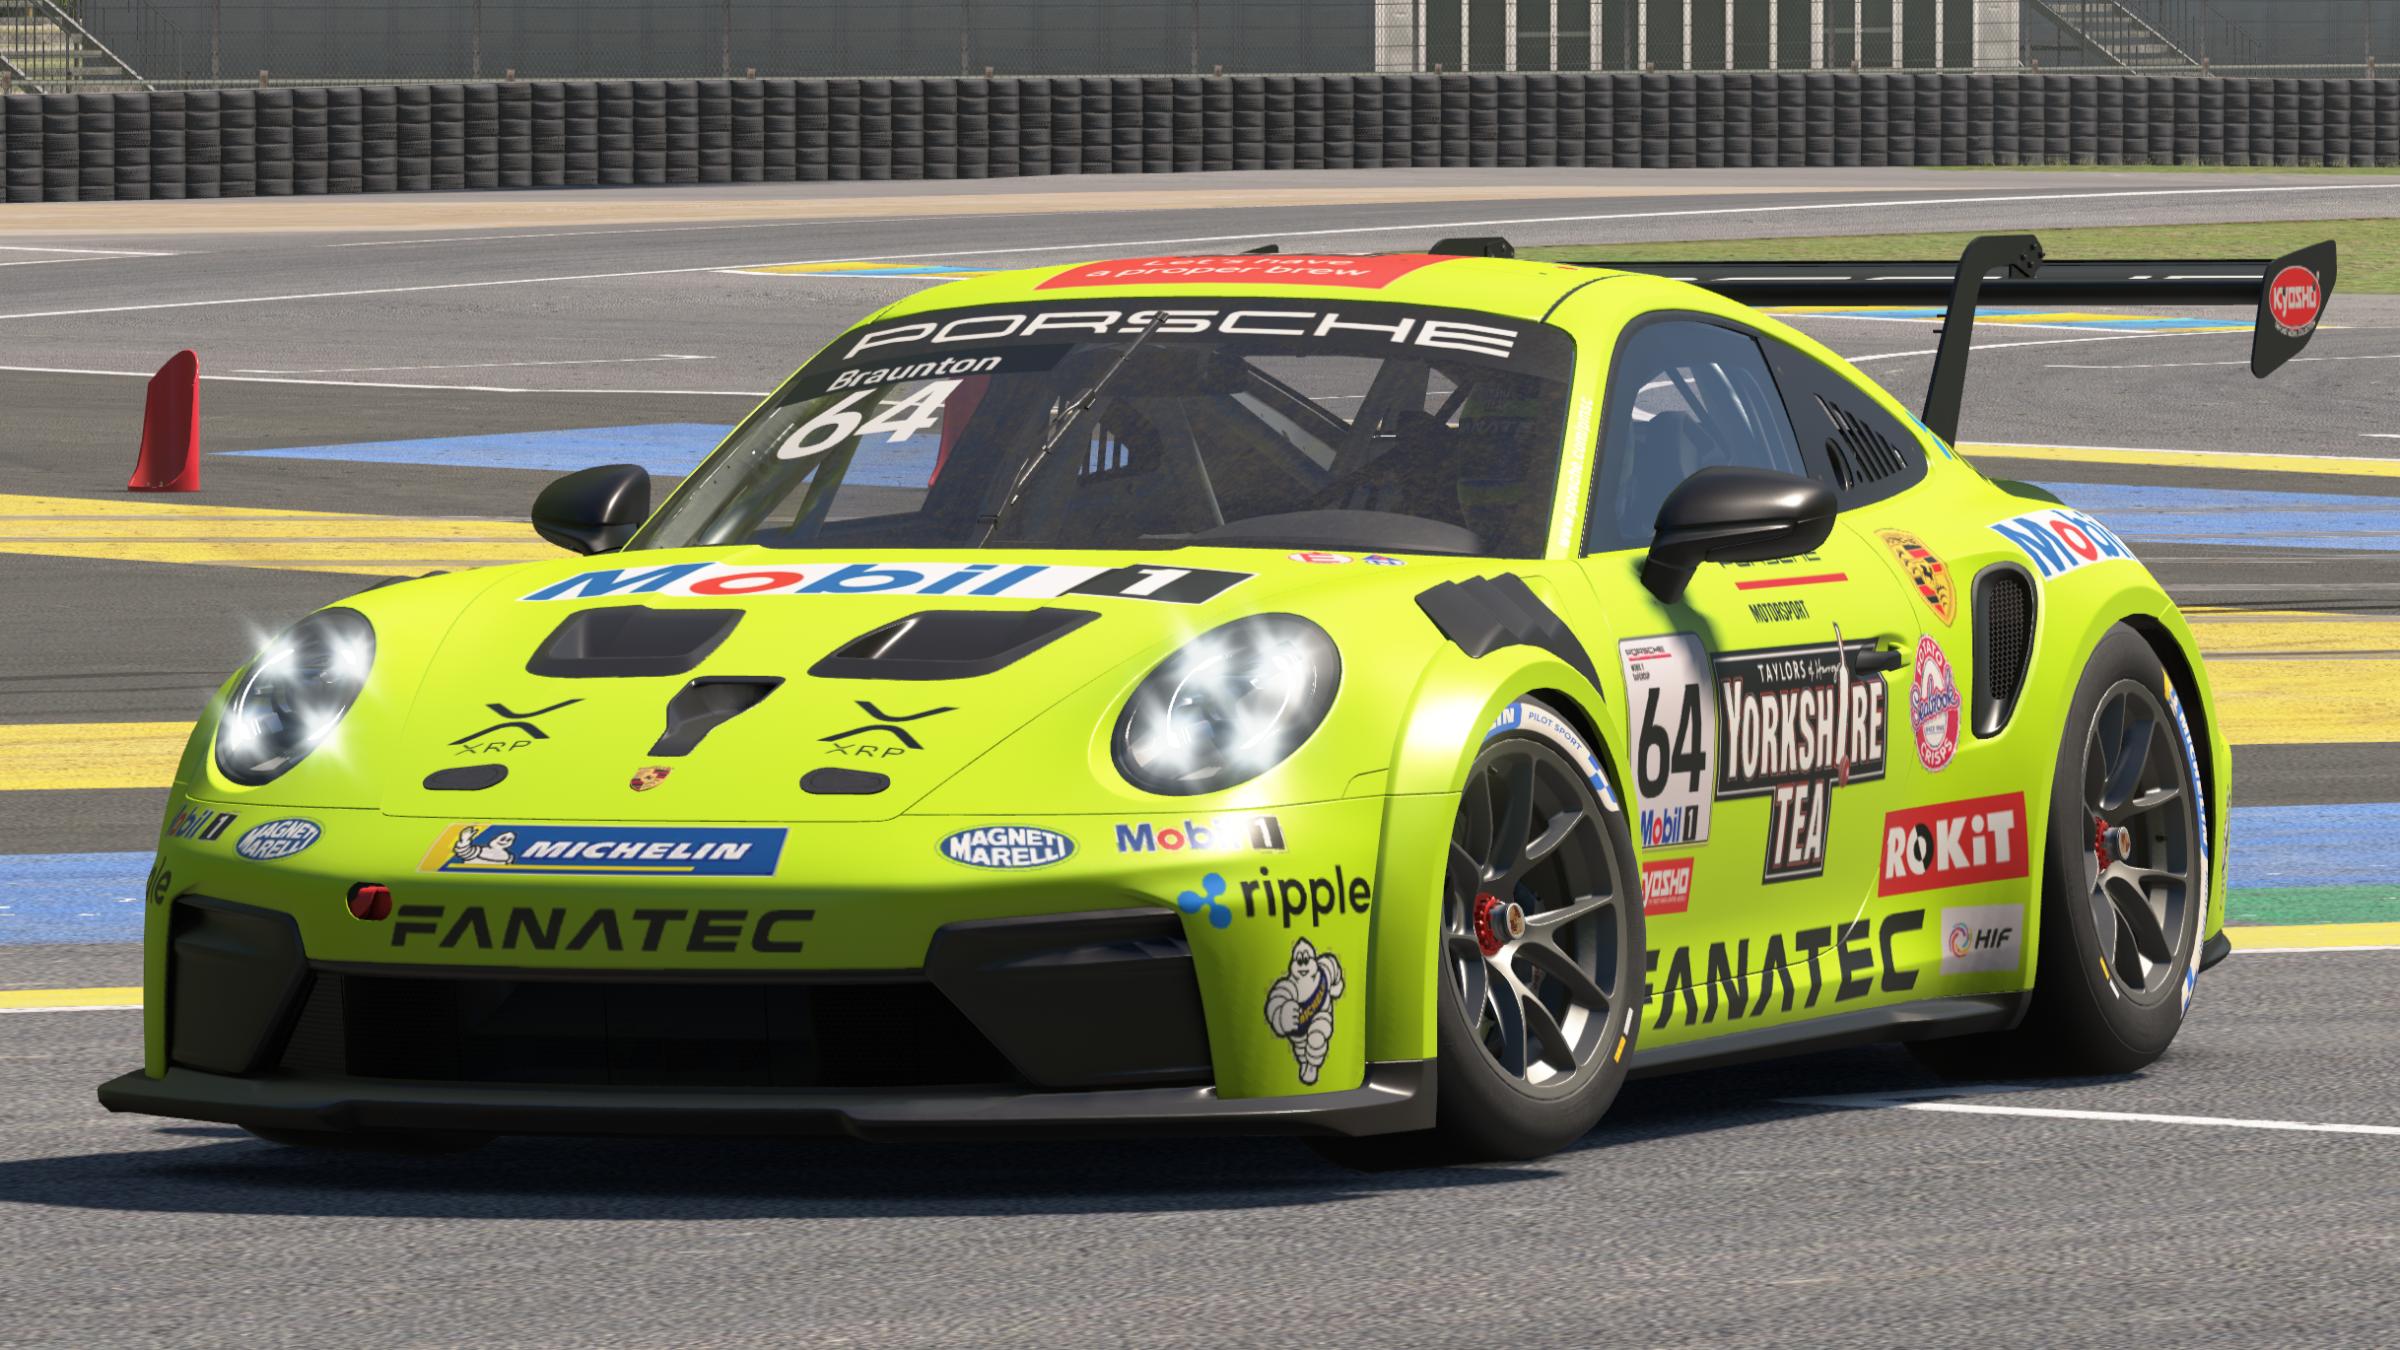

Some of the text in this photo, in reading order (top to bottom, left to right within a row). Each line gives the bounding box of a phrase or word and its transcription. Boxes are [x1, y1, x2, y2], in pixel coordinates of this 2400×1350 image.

[1086, 265, 1371, 279] a proper brew
[2273, 285, 2317, 318] KYOSHO
[843, 309, 1518, 360] PORSCHE
[825, 356, 1003, 392] Braunton
[776, 378, 964, 460] 64
[523, 561, 1193, 601] Mobil 1
[1748, 599, 1811, 624] MOTORSPORT
[1757, 659, 1806, 683] TAYLORS
[1916, 640, 1944, 677] POTATO
[1910, 665, 1960, 726] Seabrook
[1528, 711, 1583, 751] PILOT SPORT
[1637, 683, 1707, 799] 64
[1722, 678, 1884, 779] YORKSHIRE
[454, 739, 532, 758] XRP
[824, 742, 906, 759] XRP
[1920, 738, 1953, 766] CRISPS
[238, 820, 319, 845] MAGNETI
[949, 827, 1066, 849] MAGNETI
[1115, 819, 1240, 852] Mob
[1640, 806, 1682, 847] Mobil
[1774, 783, 1824, 865] TEA
[521, 839, 753, 861] MICHELIN
[949, 844, 1066, 867] MARELLI
[1240, 865, 1371, 928] ripple
[1642, 867, 1690, 908] YOSHO
[390, 904, 816, 953] FANATEC
[1976, 926, 2014, 951] HIF
